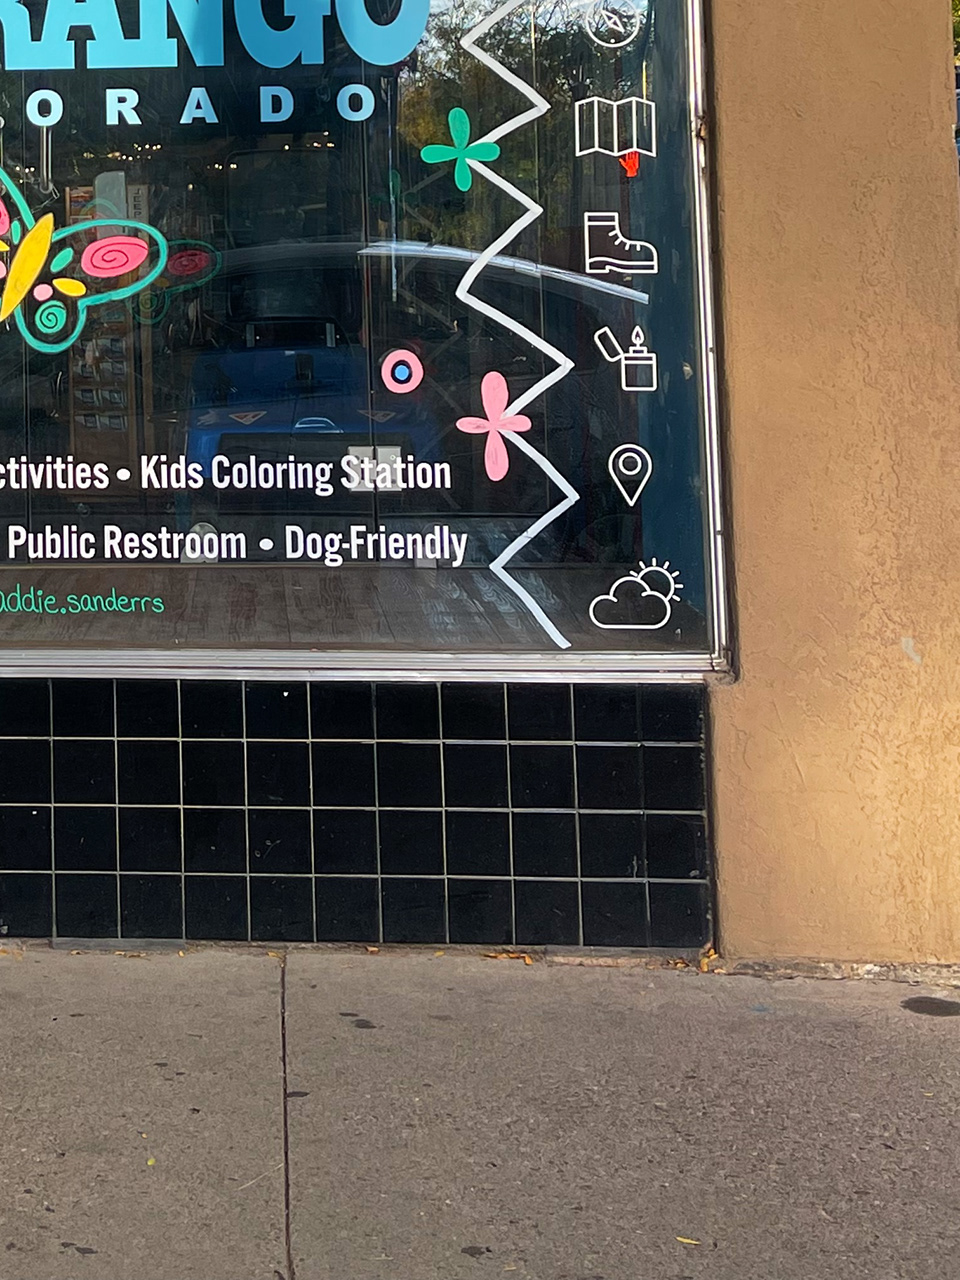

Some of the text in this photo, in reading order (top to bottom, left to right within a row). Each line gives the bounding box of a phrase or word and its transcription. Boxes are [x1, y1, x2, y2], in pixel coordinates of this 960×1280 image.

[140, 454, 204, 490] Kids
[210, 454, 334, 497] Coloring
[339, 453, 453, 490] Station
[6, 524, 97, 560] Public
[103, 524, 248, 560] Restroom
[285, 523, 469, 568] Dog-Friendly
